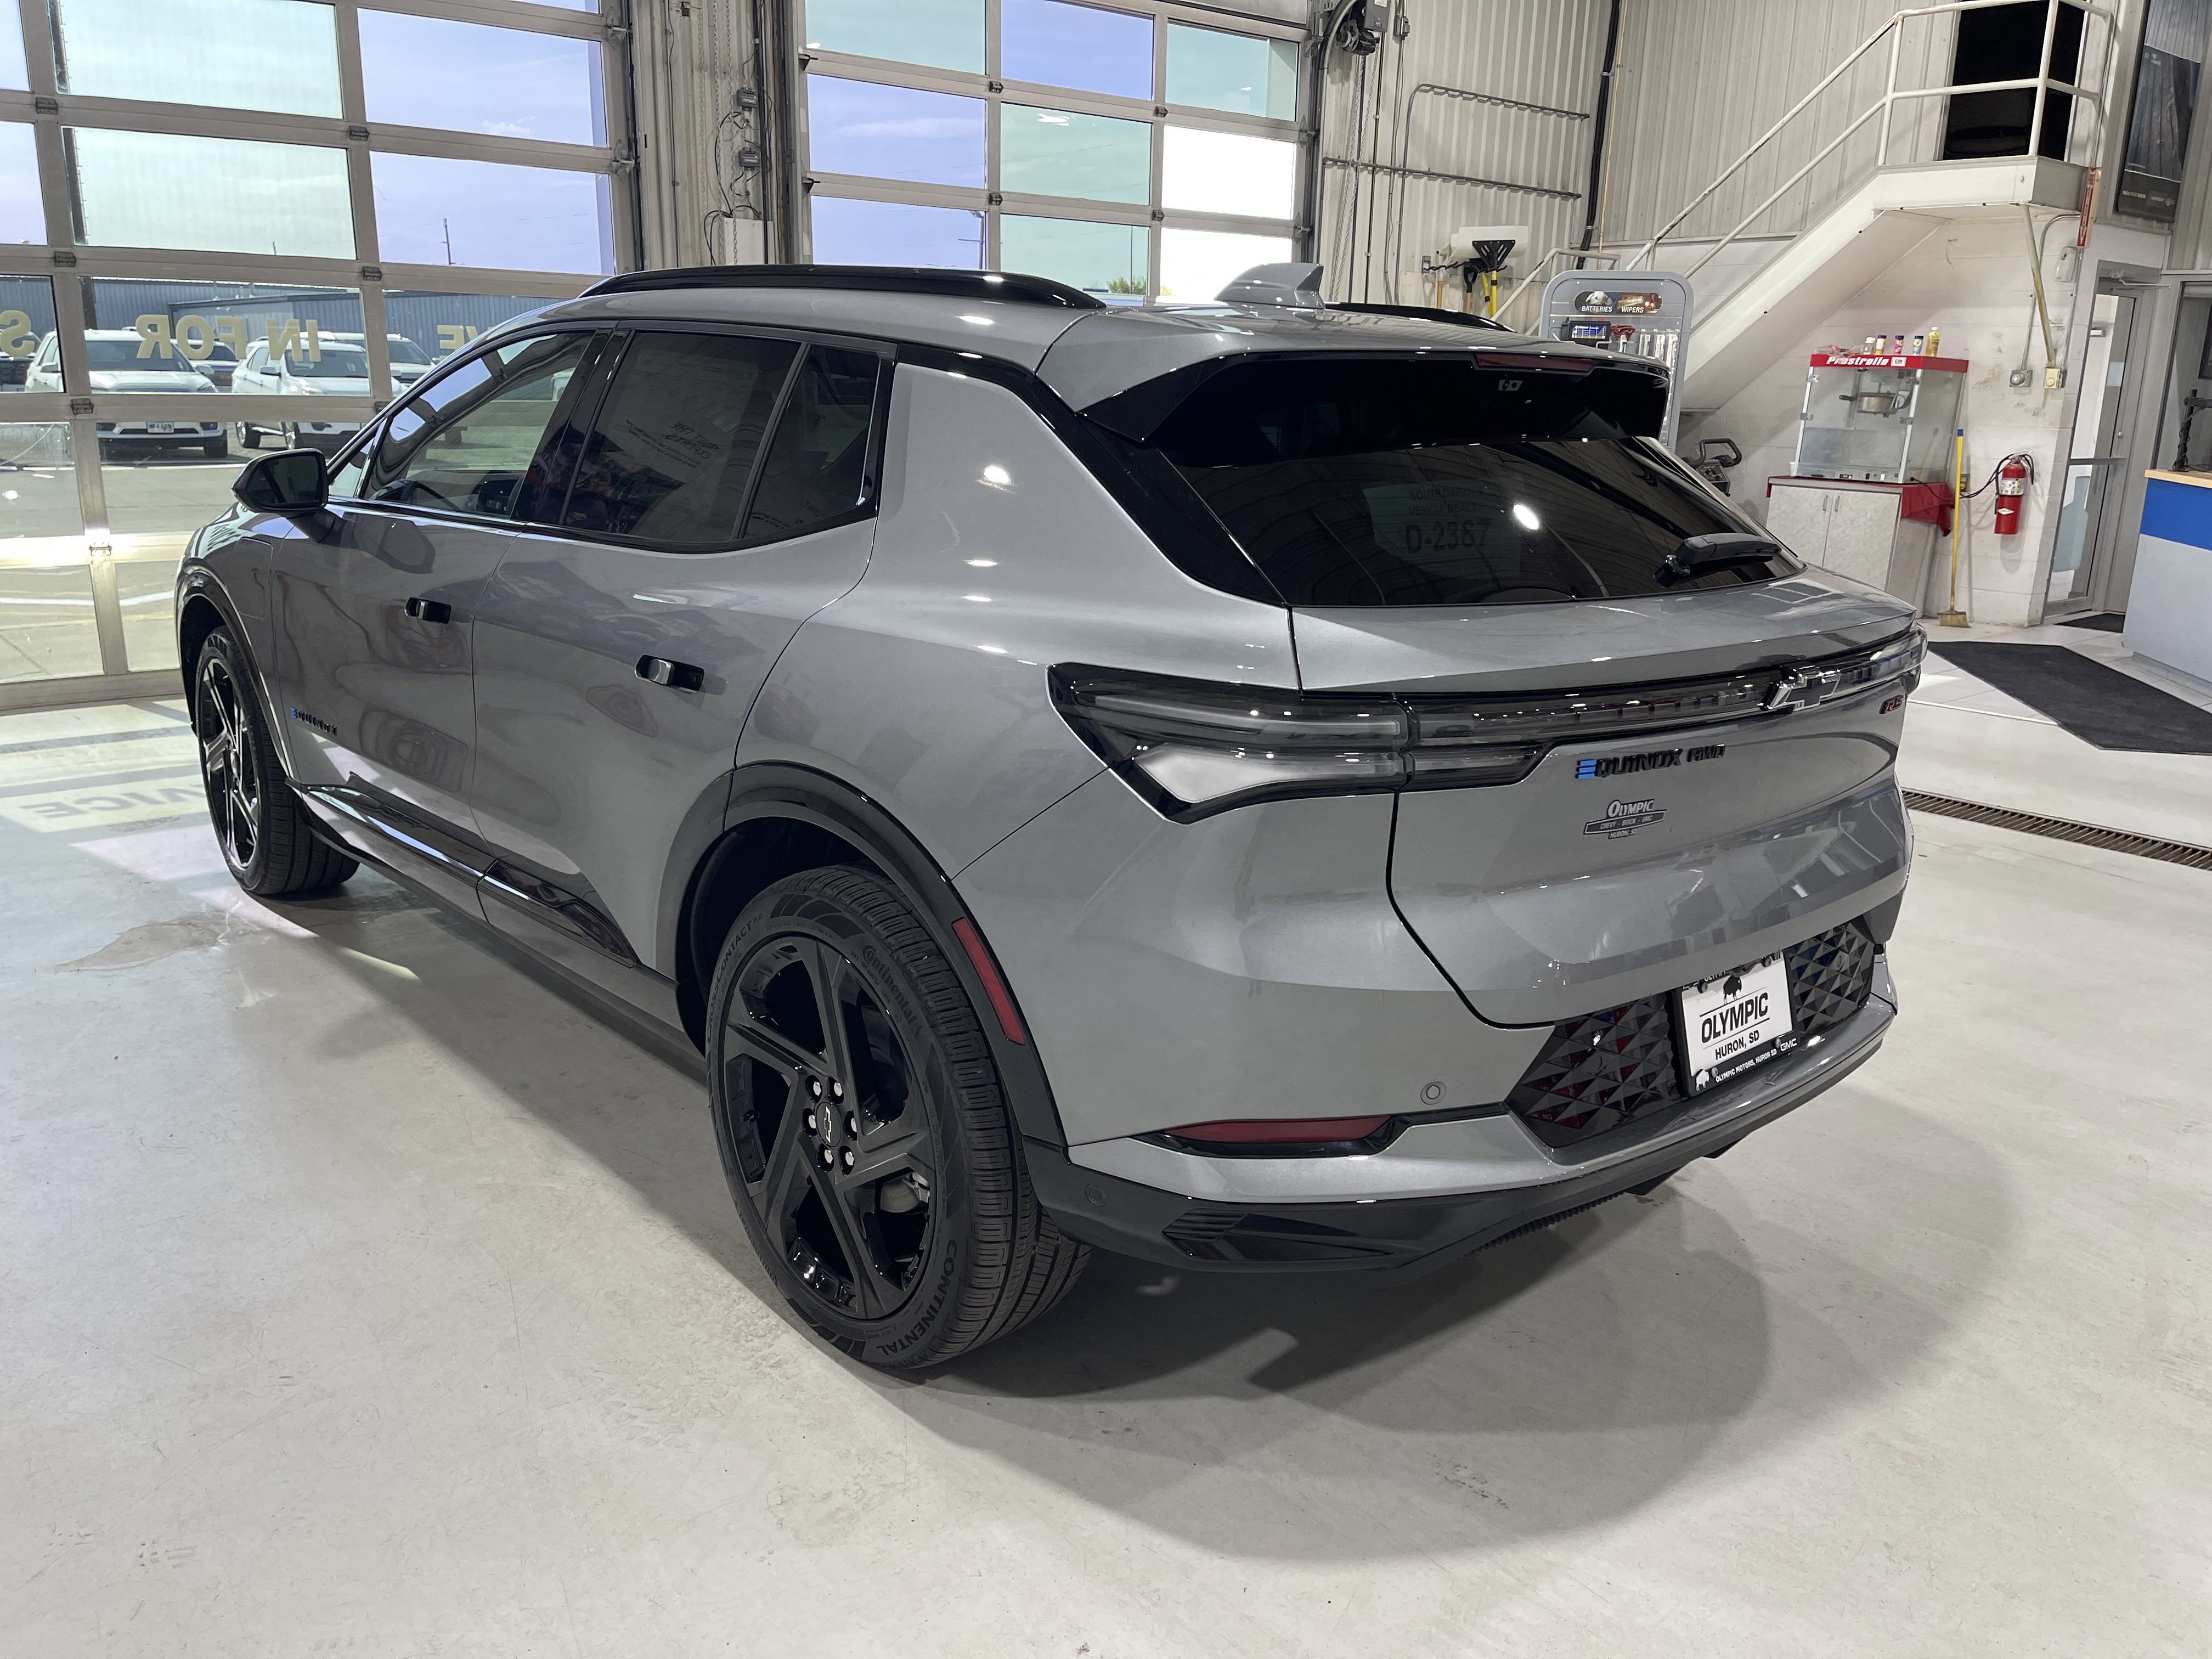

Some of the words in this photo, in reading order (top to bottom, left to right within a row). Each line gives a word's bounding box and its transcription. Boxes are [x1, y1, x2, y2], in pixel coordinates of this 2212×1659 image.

[1826, 356, 1890, 366] Prostrollo
[1576, 747, 1684, 780] EQUINOX
[1600, 821, 1617, 830] CHEVY
[1701, 992, 1768, 1043] OLYMPIC
[1716, 1037, 1747, 1060] HURON,
[1749, 1030, 1759, 1043] SD
[1780, 1037, 1797, 1052] GMC
[1716, 1068, 1735, 1083] OLYMPIC
[1735, 1059, 1756, 1074] MOTORS,
[1756, 1051, 1770, 1063] HURON
[876, 1238, 958, 1357] CONTINENTAL
